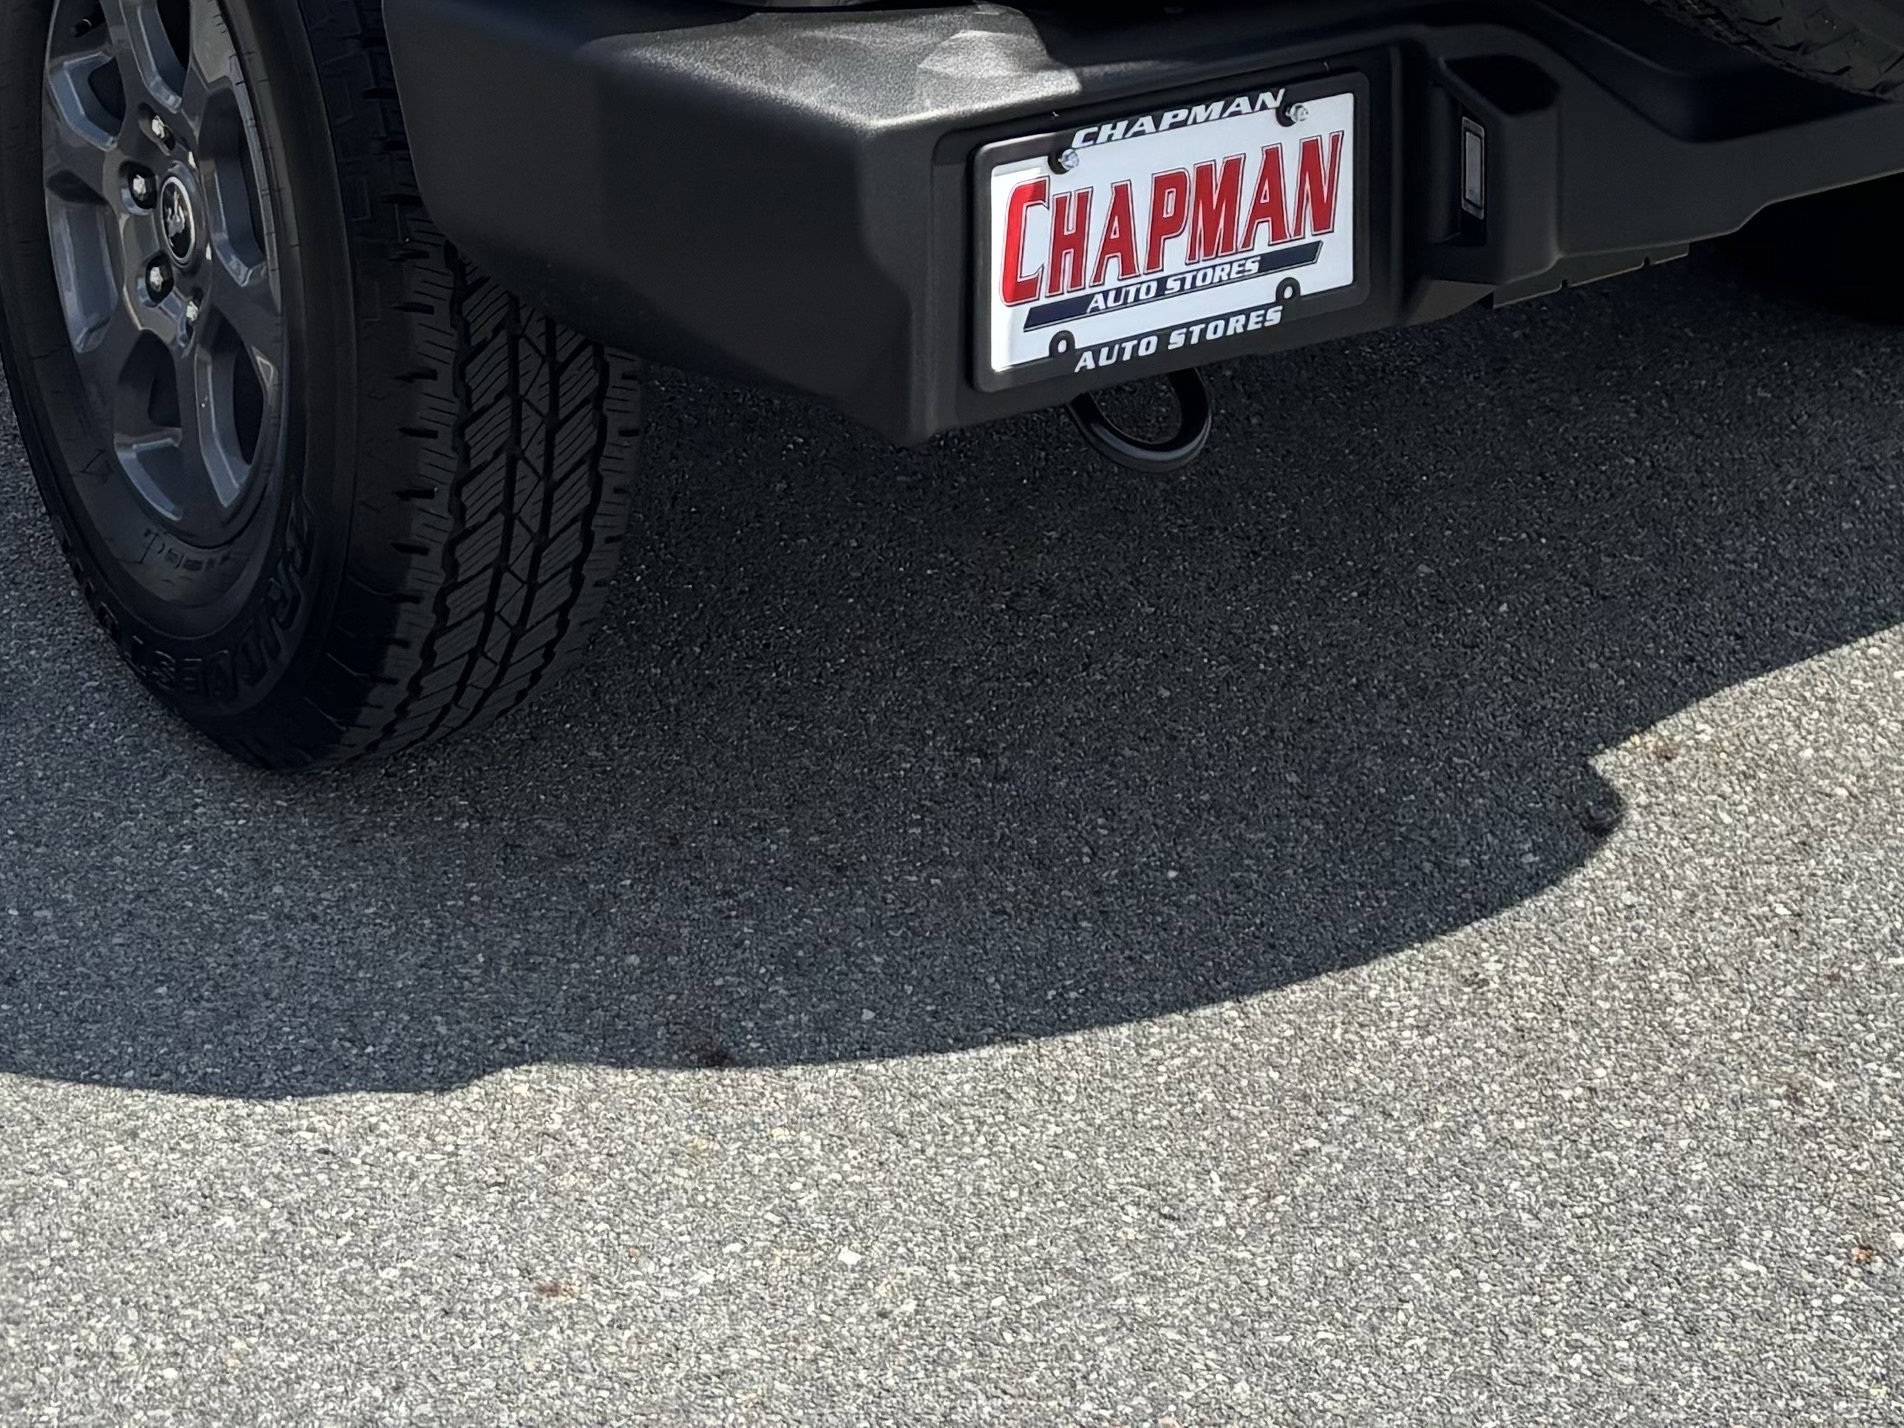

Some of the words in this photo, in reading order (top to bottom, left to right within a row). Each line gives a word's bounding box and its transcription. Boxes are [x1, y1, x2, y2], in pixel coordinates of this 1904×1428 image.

[1071, 88, 1285, 149] CHAPMAN
[999, 131, 1345, 308] CHAPMAN
[1086, 281, 1156, 314] AUTO
[1164, 257, 1261, 295] STORES
[1074, 334, 1158, 373] AUTO
[1168, 305, 1283, 351] STORES
